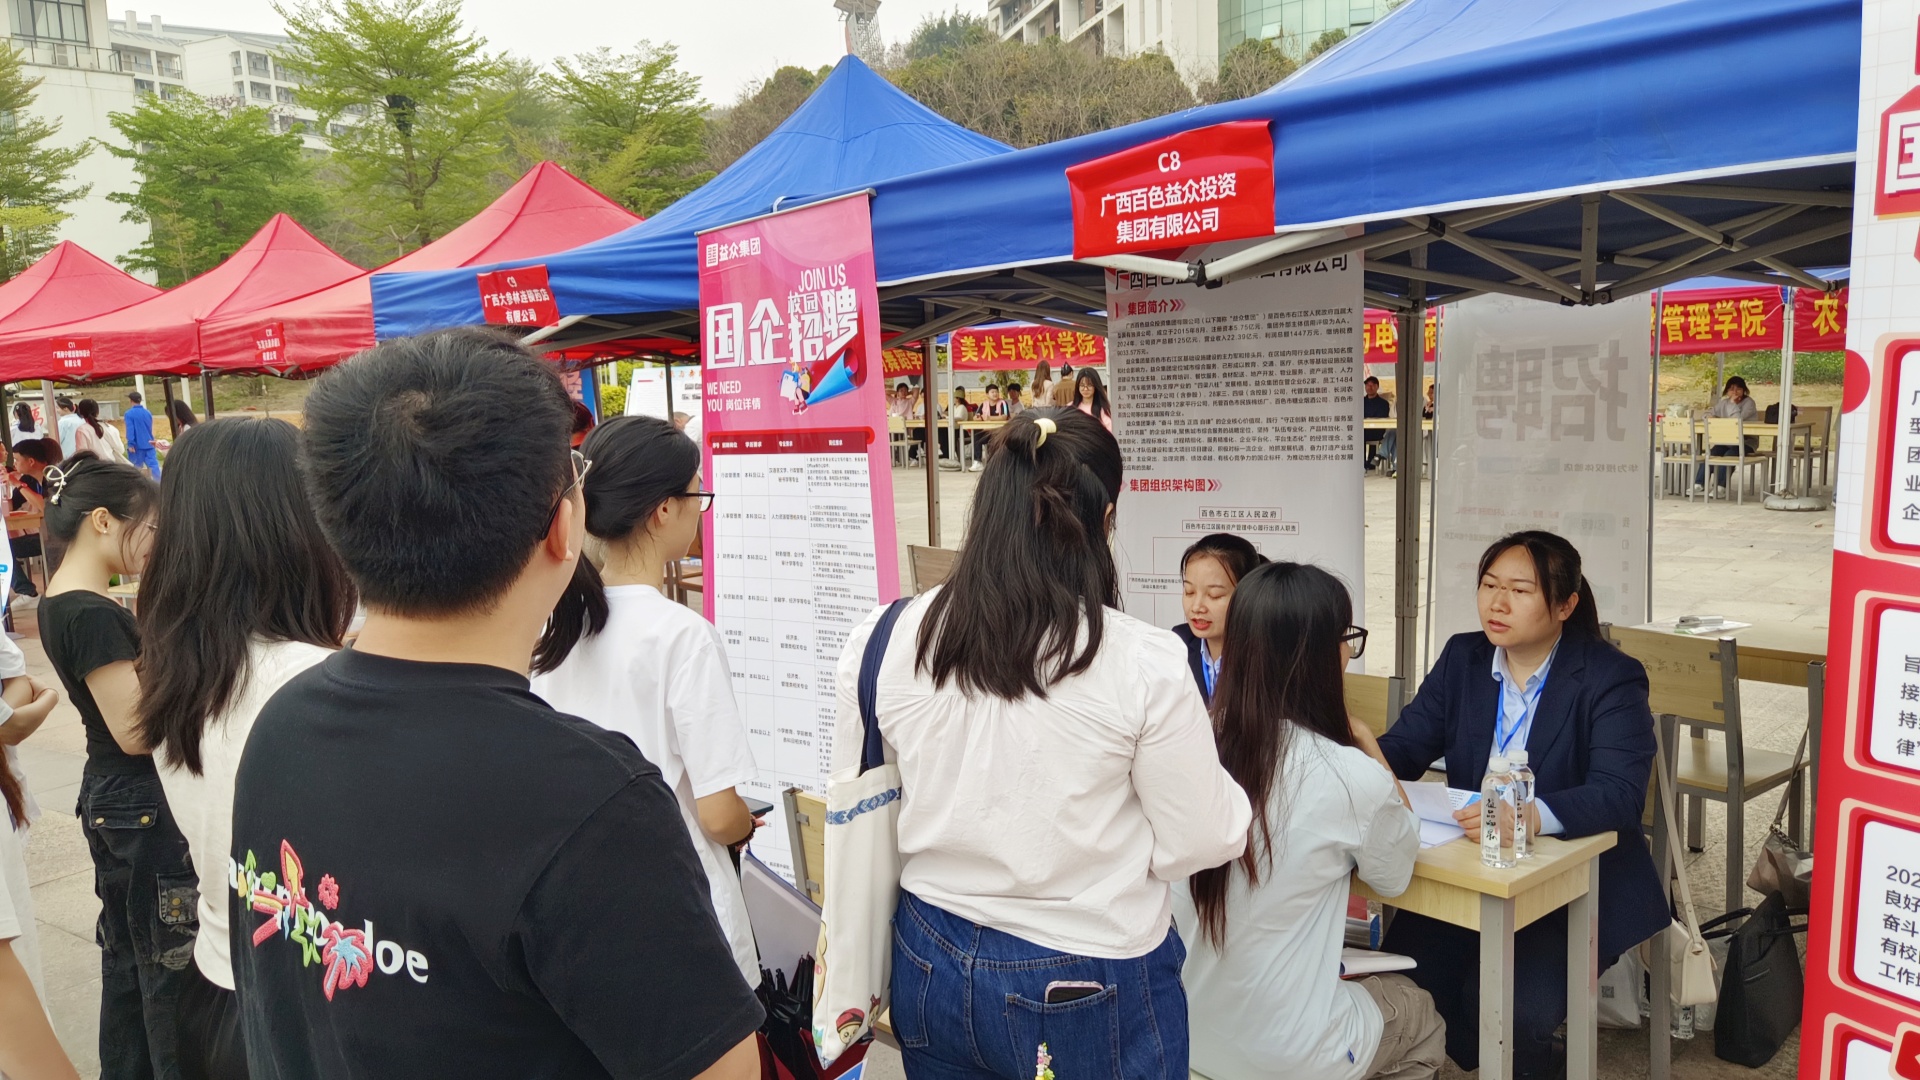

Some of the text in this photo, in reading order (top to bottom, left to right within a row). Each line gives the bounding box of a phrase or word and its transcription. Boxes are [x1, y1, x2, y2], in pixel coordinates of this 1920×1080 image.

[1158, 151, 1181, 173] C8
[1100, 172, 1236, 217] 广西百色益众投资
[1116, 207, 1219, 244] 集团有限公司
[719, 237, 761, 262] 益众集团
[798, 263, 846, 292] JOIN US
[787, 290, 818, 314] 校园
[1127, 299, 1168, 316] 集团简介
[505, 308, 537, 323] 有限公司
[1651, 298, 1767, 343] 管理学院
[1812, 294, 1849, 337] 农
[960, 331, 1096, 362] 美术与设计学院
[882, 349, 922, 373] 舞蹈学
[707, 380, 741, 395] WE NEED
[707, 398, 761, 412] YOU 岗位详情
[1129, 479, 1206, 492] 集团组织架构图
[1201, 509, 1277, 518] 百色市右江区人民政府
[1902, 503, 1920, 521] 企
[1900, 682, 1920, 702] 接
[1898, 710, 1920, 730] 持
[1885, 889, 1920, 914] 良好
[1882, 914, 1920, 938] 奋斗
[1880, 937, 1920, 965] 有校
[1878, 961, 1920, 987] 工作
